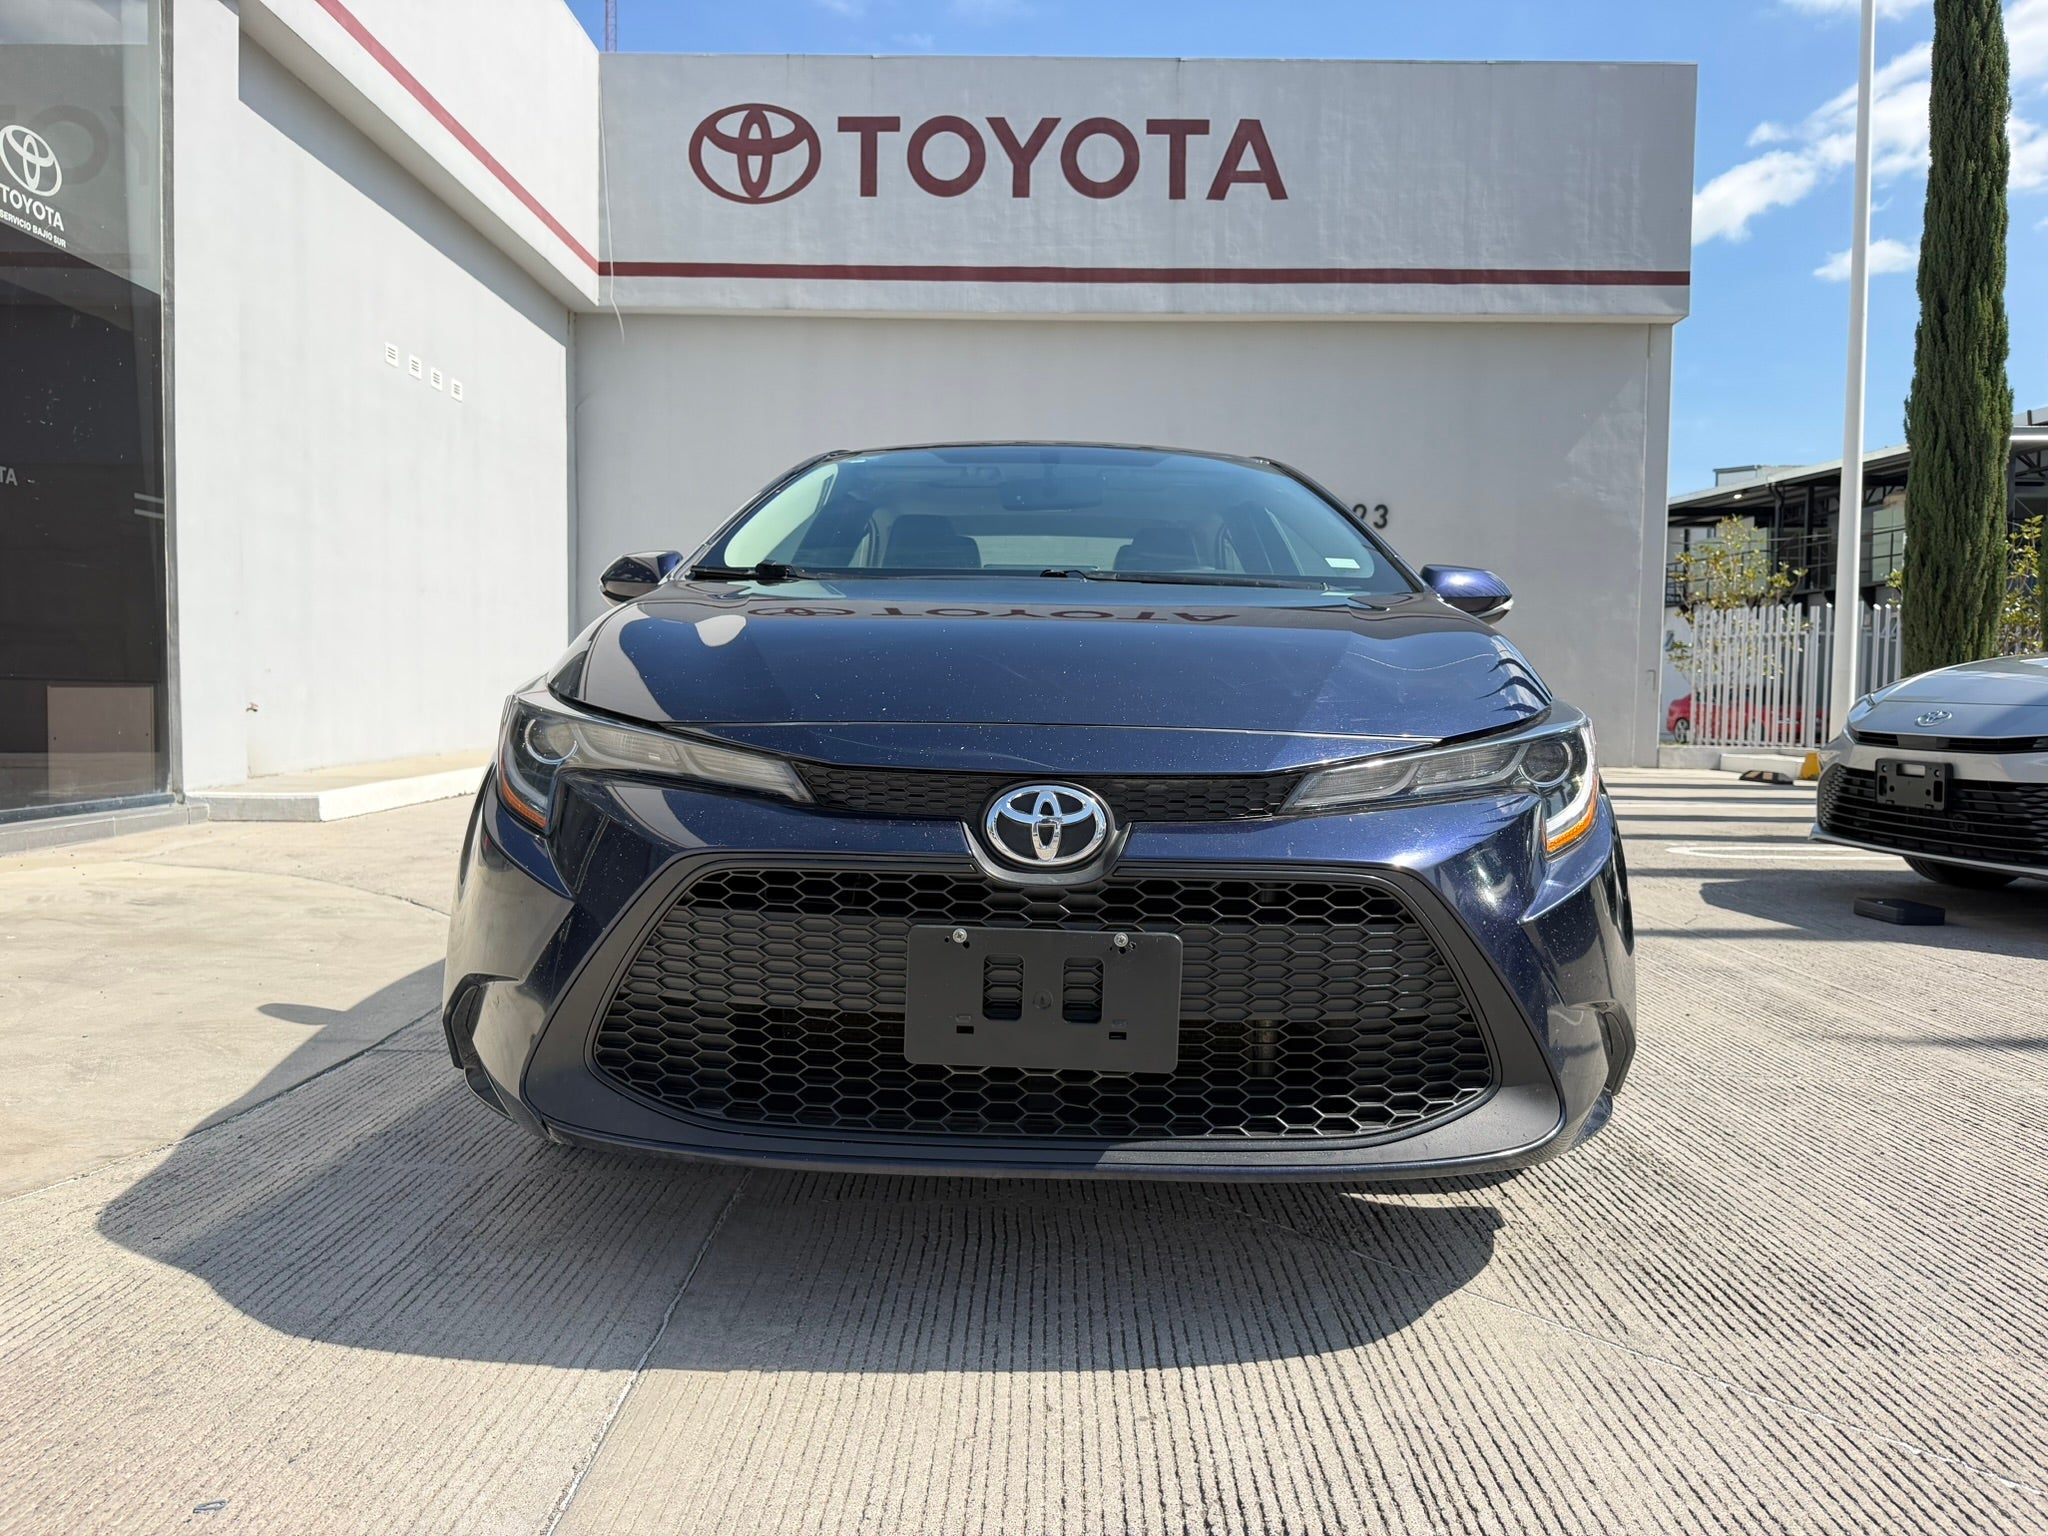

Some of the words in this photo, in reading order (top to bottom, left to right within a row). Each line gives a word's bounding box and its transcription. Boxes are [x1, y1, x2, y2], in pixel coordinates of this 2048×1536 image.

[838, 115, 1288, 200] TOYOTA
[0, 183, 64, 231] TOYOTA
[0, 209, 31, 231] SERVICIO
[53, 235, 66, 248] SUR
